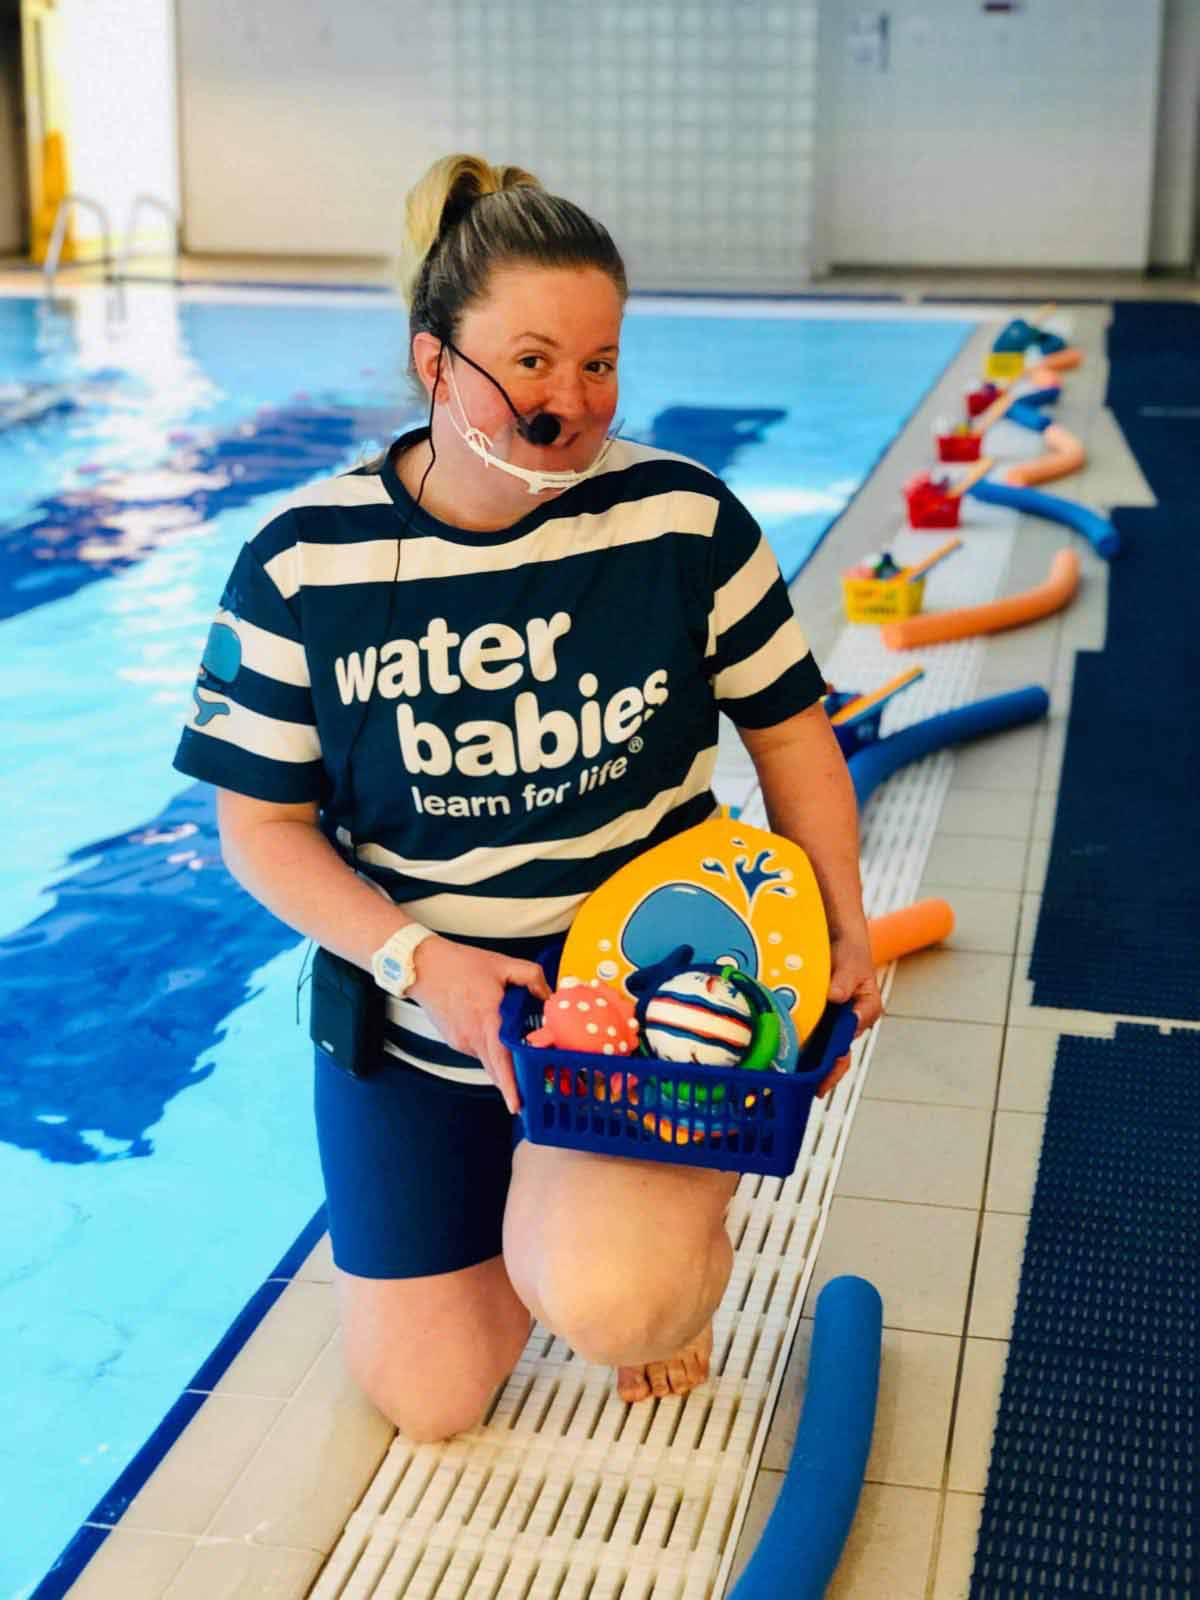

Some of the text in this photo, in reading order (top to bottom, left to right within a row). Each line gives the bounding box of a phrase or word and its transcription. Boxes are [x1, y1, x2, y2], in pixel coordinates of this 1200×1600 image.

[335, 611, 572, 705] water
[396, 669, 669, 777] babies
[411, 755, 628, 817] learn for life
